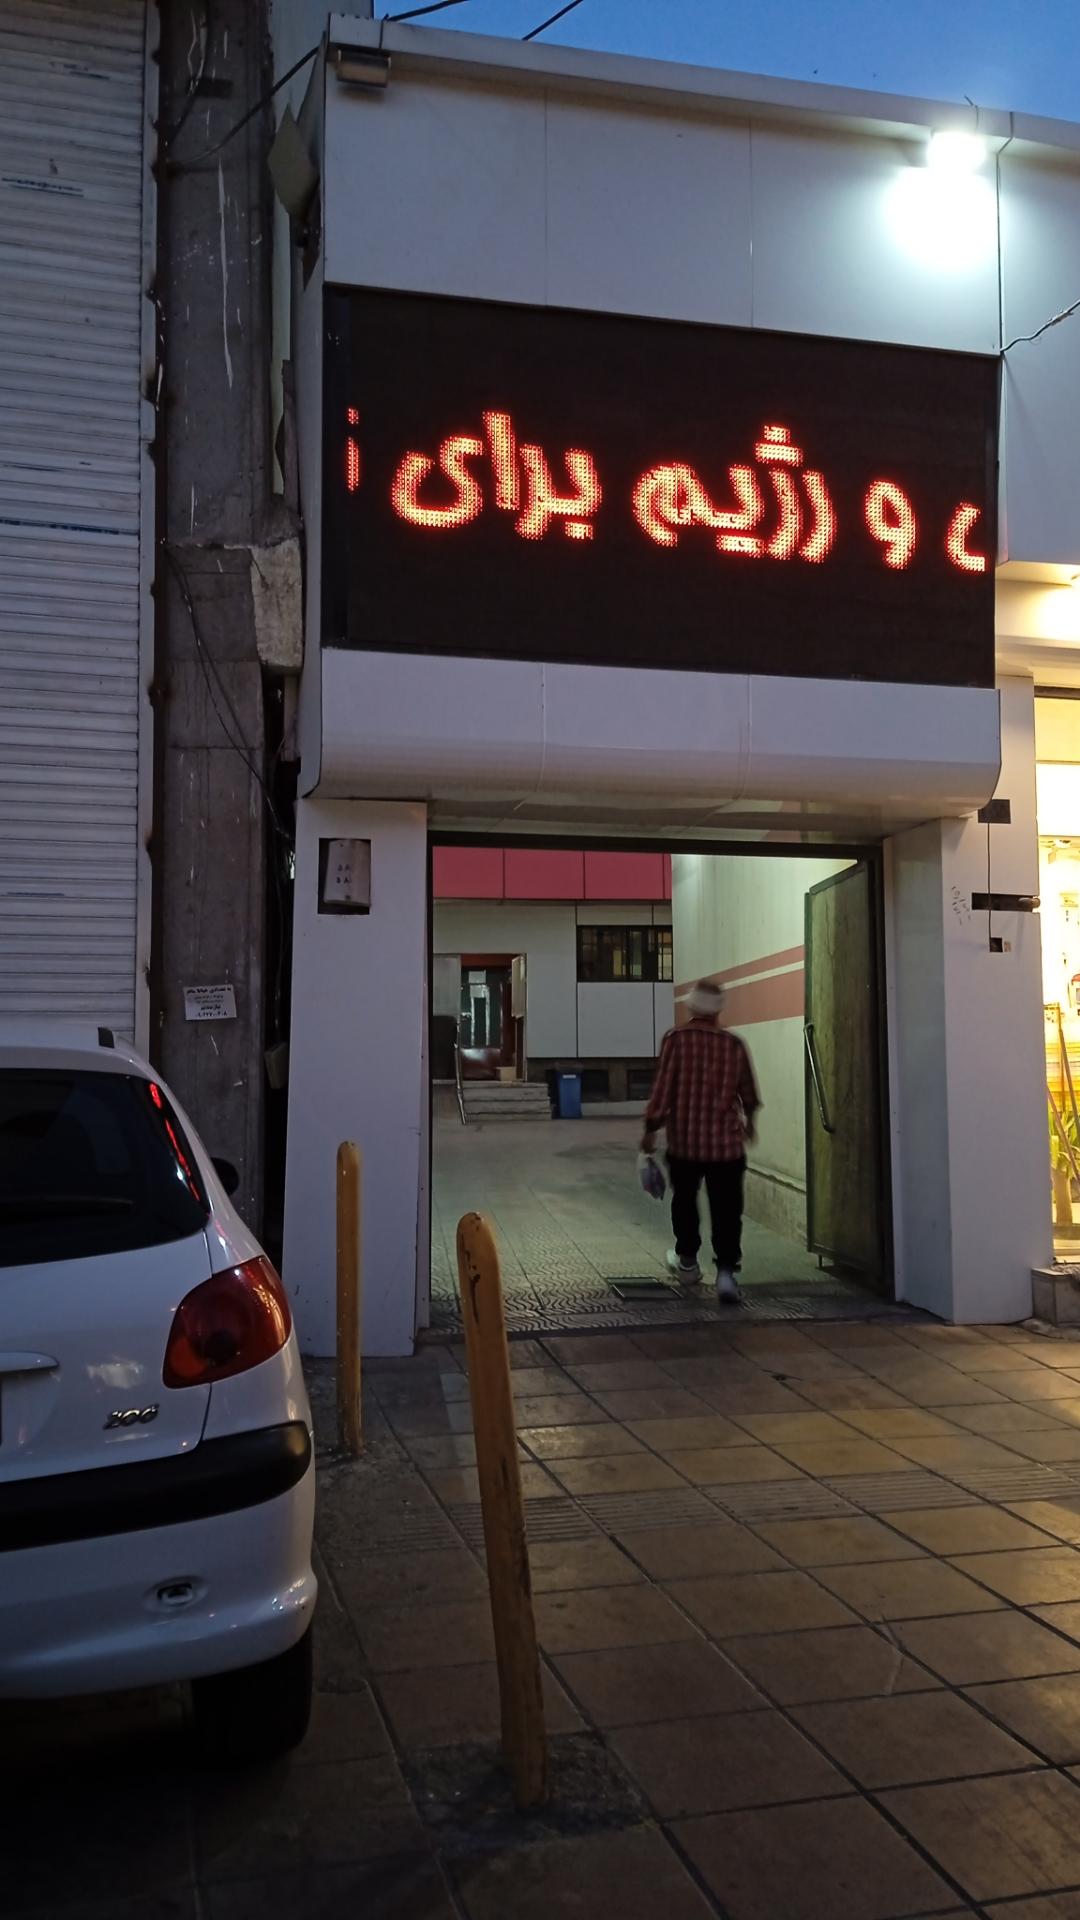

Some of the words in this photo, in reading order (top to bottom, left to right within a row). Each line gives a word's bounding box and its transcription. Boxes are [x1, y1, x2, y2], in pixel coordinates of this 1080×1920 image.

[391, 411, 603, 540] برای
[632, 424, 837, 564] رژیم
[864, 480, 919, 570] و
[102, 1403, 160, 1430] 206
